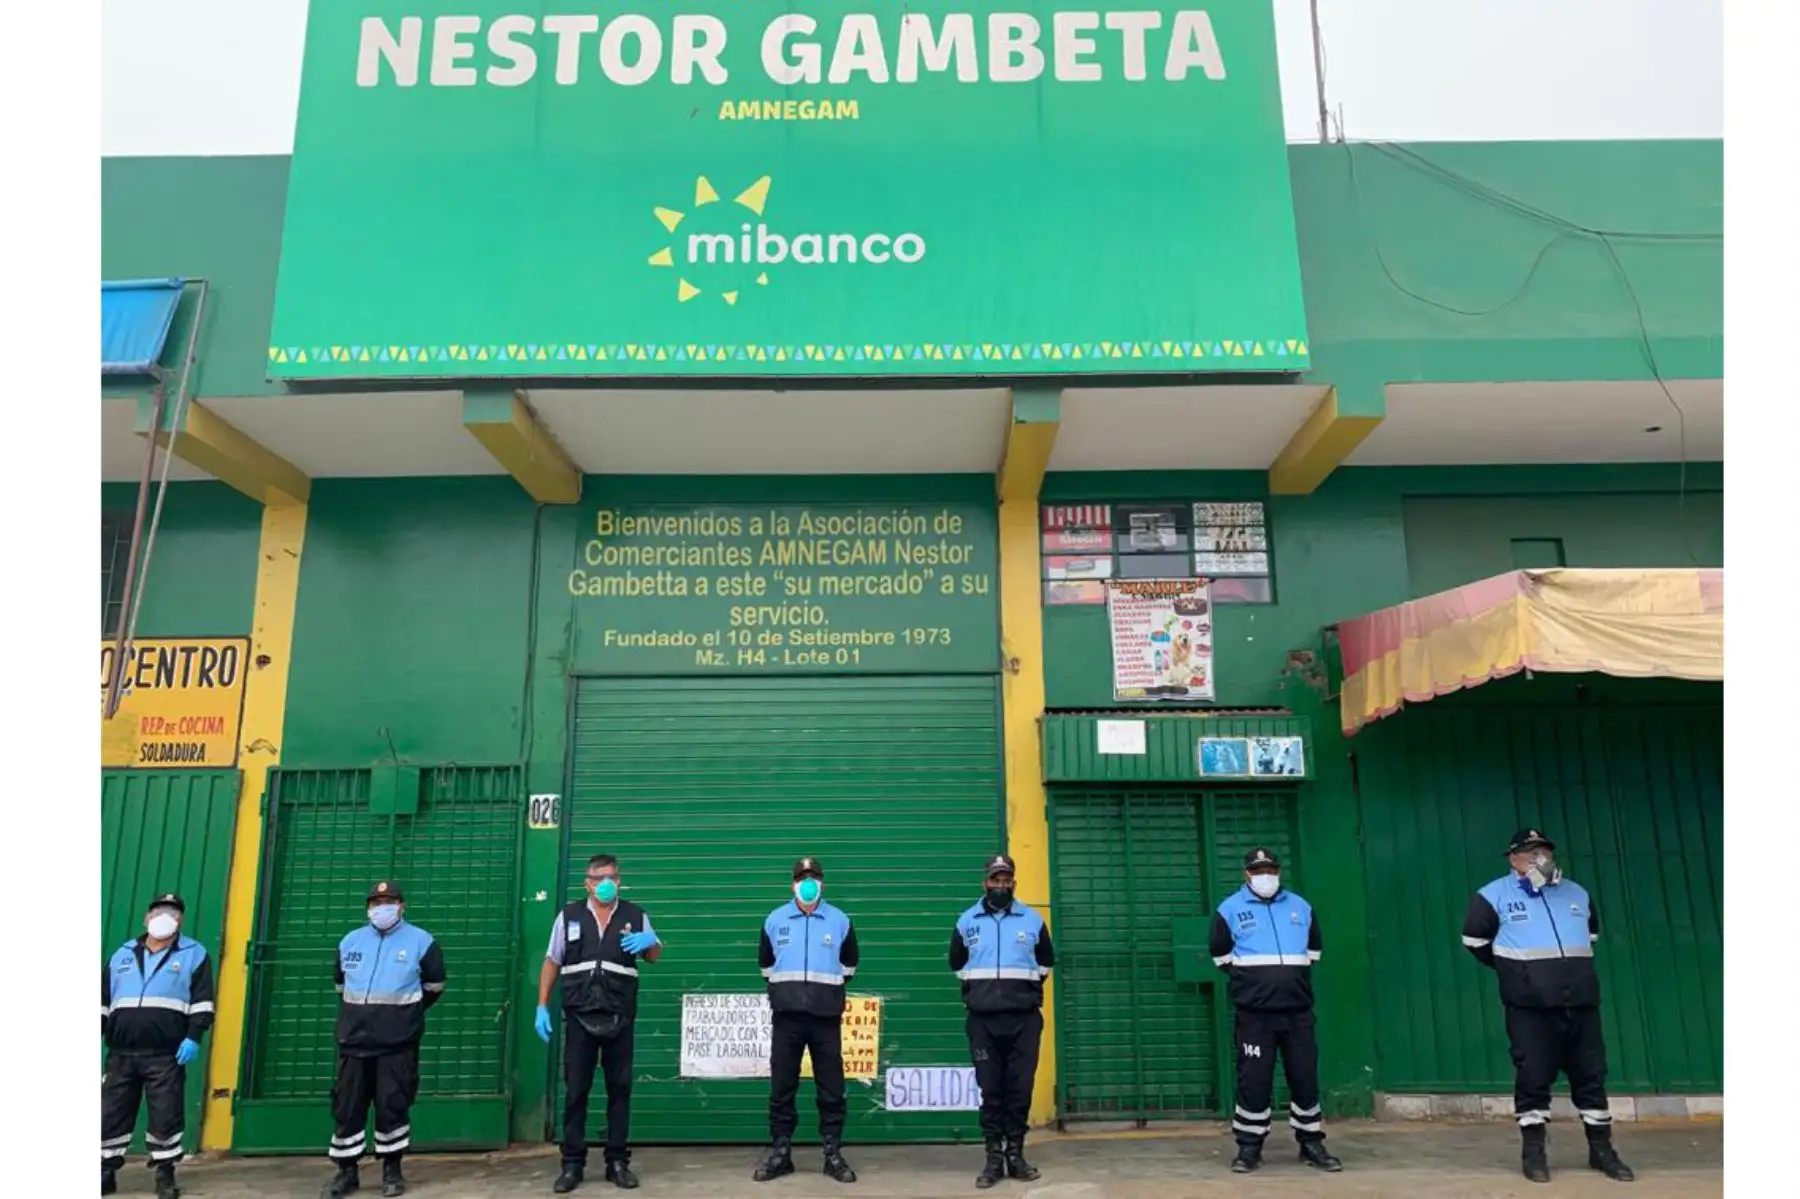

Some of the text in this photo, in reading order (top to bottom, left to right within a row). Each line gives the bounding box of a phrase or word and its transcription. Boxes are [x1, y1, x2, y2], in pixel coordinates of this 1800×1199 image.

[356, 10, 1226, 87] NESTOR GAMBETA
[719, 100, 860, 120] AMNEGAM
[688, 223, 926, 264] mibanco
[597, 509, 963, 536] Bienvenidos a la Asociación de
[585, 539, 974, 566] Comerciantes AMNEGAM Nestor
[568, 568, 688, 596] Gambetta
[695, 576, 709, 596] a
[716, 572, 767, 596] este
[941, 574, 955, 595] a
[962, 574, 989, 595] su
[730, 601, 830, 627] servicio.
[604, 628, 952, 647] Fundado el 10 de Setiembre 1973
[695, 648, 731, 666] Mz.
[737, 648, 767, 666] H4
[784, 648, 831, 666] Lote
[835, 648, 861, 665] 01
[179, 716, 224, 735] COCINA
[139, 742, 206, 762] SOLDADURA
[686, 1009, 757, 1025] TRABAJADORES
[738, 1026, 758, 1041] CON
[687, 1042, 711, 1057] PASE
[845, 1060, 874, 1073] STIR
[891, 1068, 979, 1107] SALIDA
